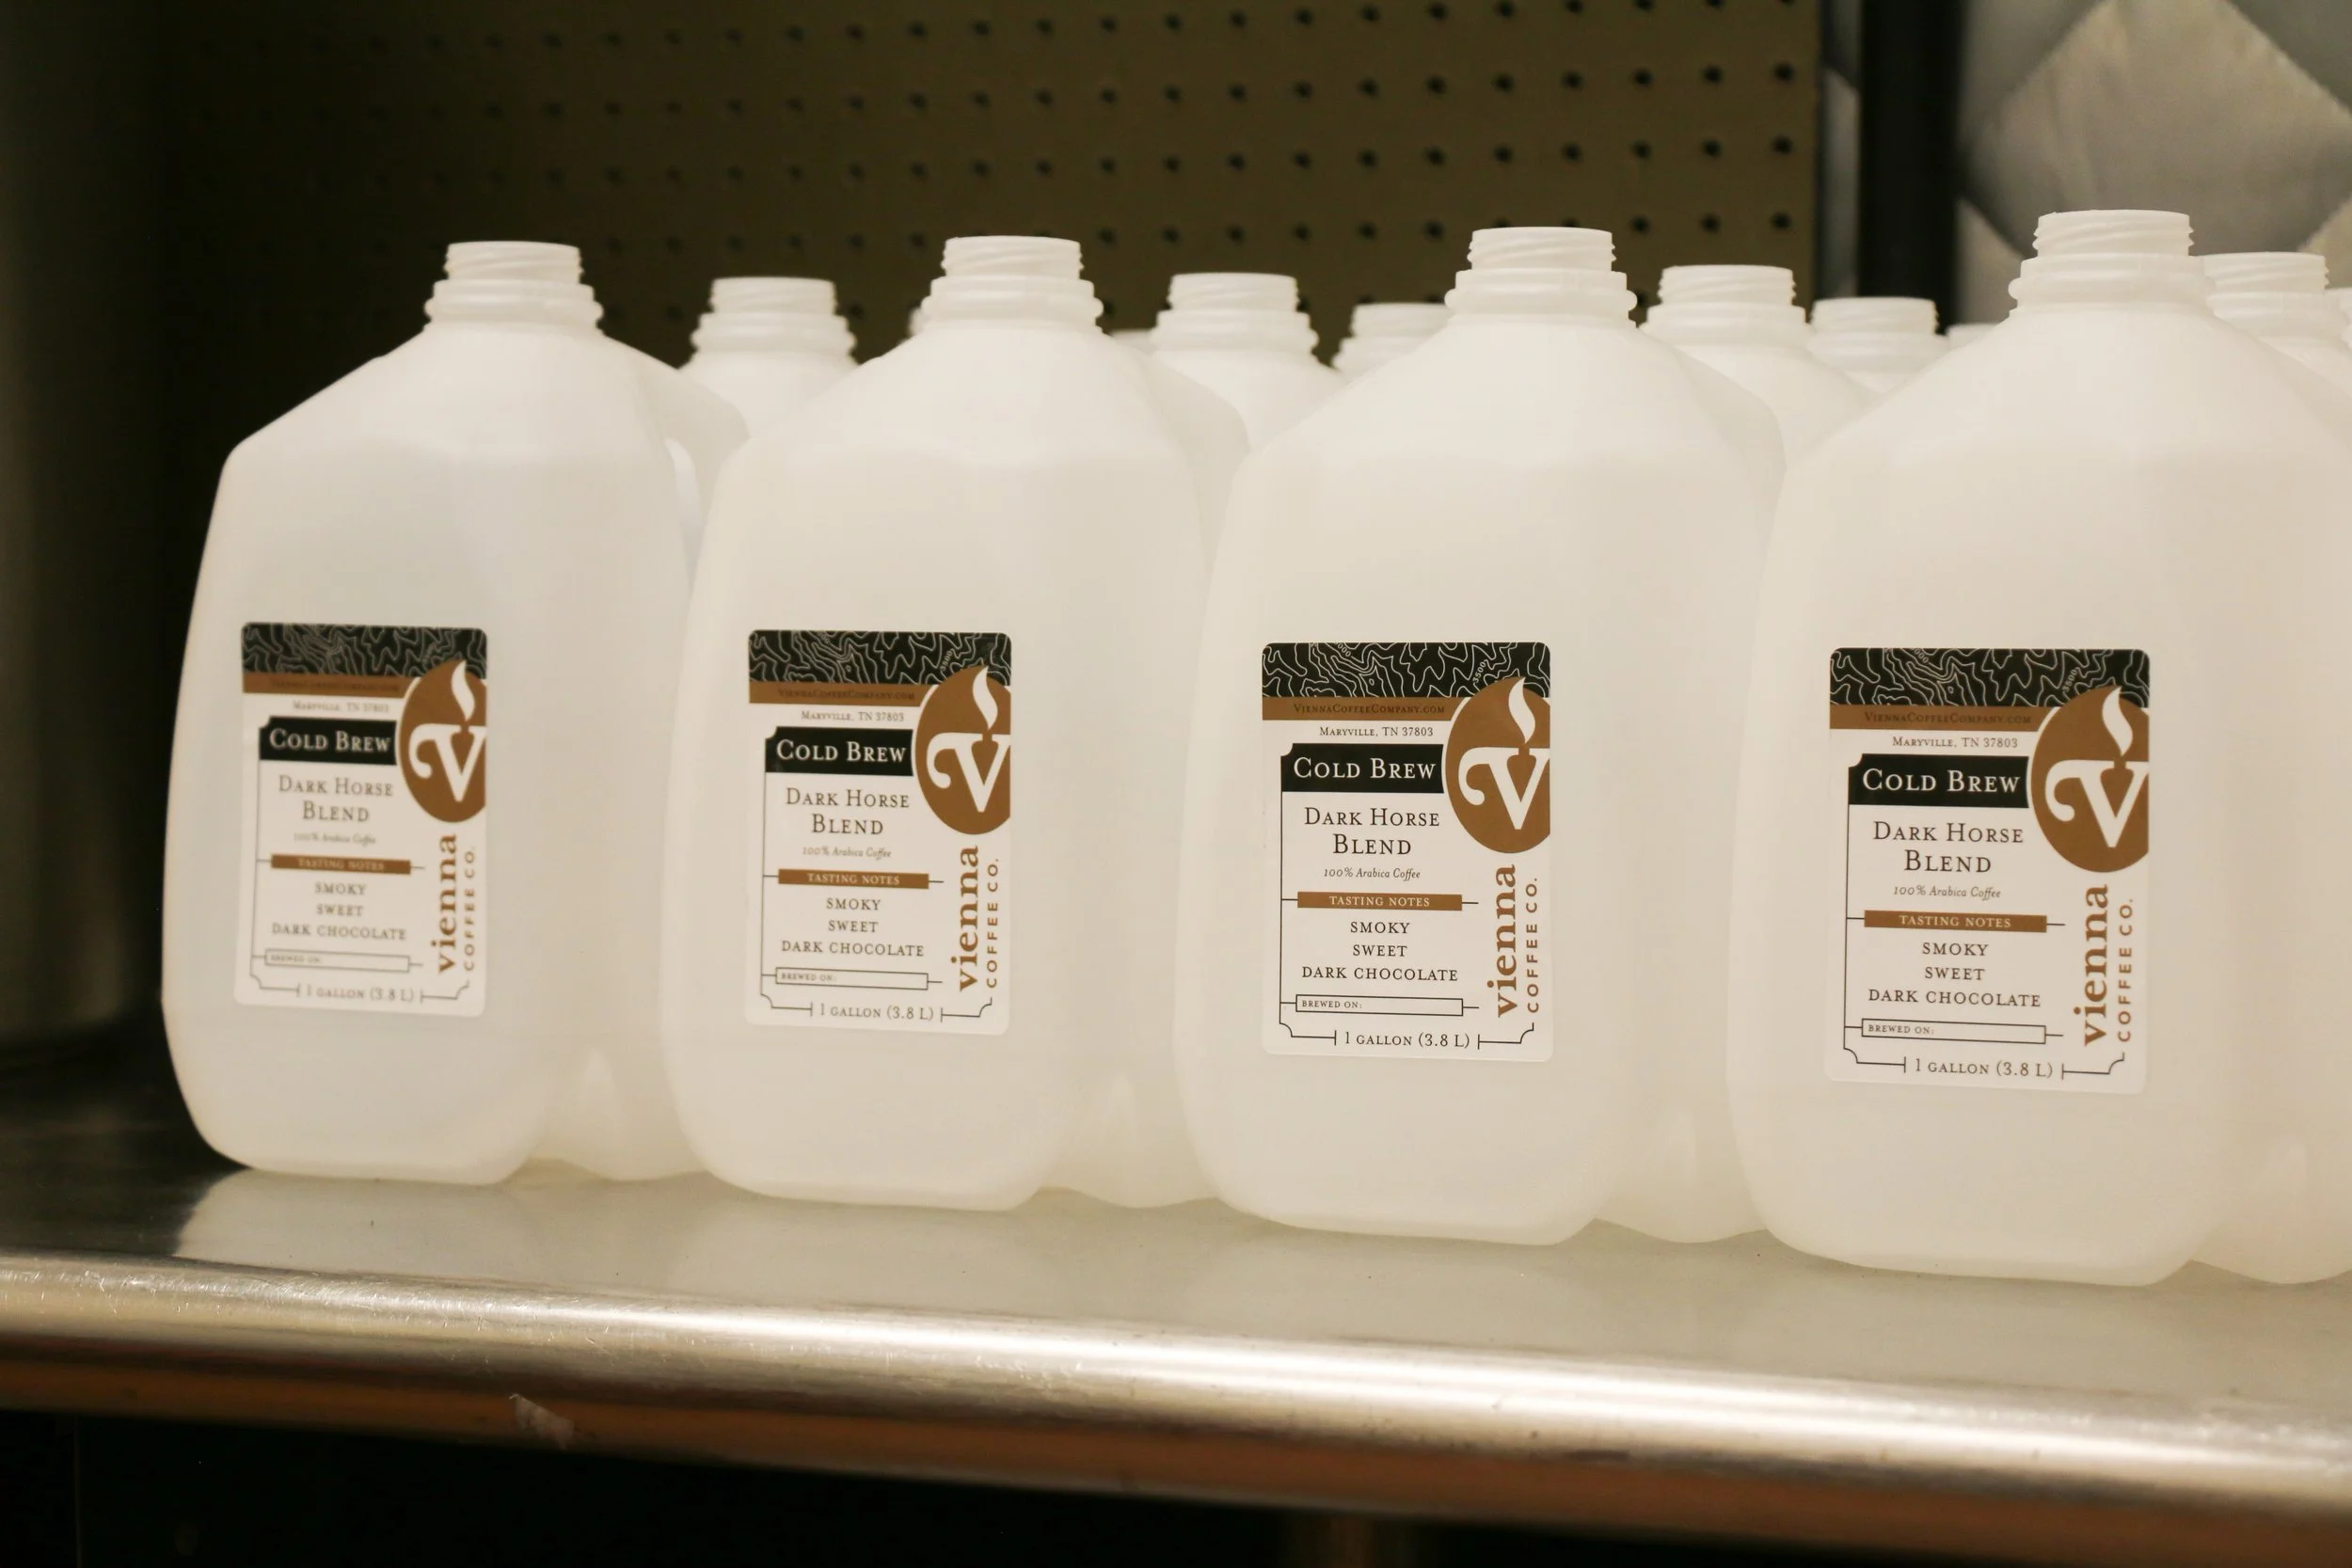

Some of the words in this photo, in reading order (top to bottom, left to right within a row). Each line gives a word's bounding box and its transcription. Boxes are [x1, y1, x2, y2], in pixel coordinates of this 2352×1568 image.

[269, 728, 327, 750] COLD
[336, 731, 391, 752] BREW
[1382, 726, 1399, 736] TN
[1402, 727, 1434, 736] 37803
[776, 739, 838, 761] COLD
[847, 741, 906, 763] BREW
[1962, 737, 1979, 747] TN
[1983, 737, 2018, 748] 37803
[1294, 757, 1360, 779] COLD
[1370, 758, 1437, 779] BREW
[279, 775, 326, 794] DARK
[336, 777, 392, 796] HORSE
[1862, 768, 1936, 791] COLD
[1947, 769, 2021, 792] BREW
[787, 787, 838, 806] DARK
[847, 789, 910, 808] HORSE
[303, 801, 368, 821] BLEND
[1305, 807, 1362, 826] DARK
[1370, 808, 1439, 827] HORSE
[812, 814, 883, 835] BLEND
[1873, 821, 1937, 841] DARK
[1947, 823, 2024, 843] HORSE
[1333, 833, 1411, 855] BLEND
[1904, 849, 1991, 873] BLEND
[807, 872, 858, 884] TASTING
[863, 874, 899, 885] NOTES
[1325, 867, 1354, 878] 100%
[1356, 868, 1390, 879] Arabica
[1393, 869, 1421, 881] Coffee
[314, 882, 366, 895] SMOKY
[1526, 879, 1538, 913] CO.
[1894, 886, 1926, 896] 100%
[1930, 886, 1967, 896] Arabica
[1971, 887, 2001, 901] Coffee
[431, 834, 457, 974] vienna
[826, 897, 882, 911] SMOKY
[1329, 895, 1384, 906] TASTING
[1390, 896, 1430, 907] NOTES
[317, 905, 363, 917] SWEET
[950, 846, 978, 992] vienna
[2120, 898, 2134, 936] CO.
[464, 889, 475, 971] COFFEE
[828, 920, 879, 933] SWEET
[1350, 922, 1410, 934] SMOKY
[1899, 915, 1960, 927] TASTING
[1965, 916, 2011, 928] NOTES
[272, 924, 311, 937] DARK
[317, 925, 406, 940] CHOCOLATE
[1487, 864, 1518, 1018] vienna
[782, 941, 823, 953] DARK
[829, 942, 924, 957] CHOCOLATE
[988, 902, 998, 989] COFFEE
[1353, 944, 1407, 957] SWEET
[1922, 942, 1989, 956] SMOKY
[1302, 966, 1347, 979] DARK
[1354, 968, 1458, 981] CHOCOLATE
[1526, 924, 1539, 1013] COFFEE
[1925, 967, 1985, 980] SWEET
[2074, 884, 2108, 1046] vienna
[1868, 990, 1918, 1003] DARK
[1926, 990, 2042, 1007] CHOCOLATE
[2118, 947, 2132, 1042] COFFEE
[1302, 1000, 1341, 1008] BREWED
[831, 1006, 882, 1018] GALLON
[919, 1006, 934, 1022] L)
[1868, 1025, 1911, 1034] BREWED
[1345, 1031, 1350, 1044] 1
[1356, 1035, 1412, 1046] GALLON
[1419, 1032, 1448, 1048] (3.8
[1454, 1034, 1470, 1048] L)
[1915, 1058, 1921, 1071] 1
[1928, 1063, 1989, 1074] GALLON
[1996, 1062, 2029, 1077] (3.8
[2036, 1064, 2053, 1078] L)
